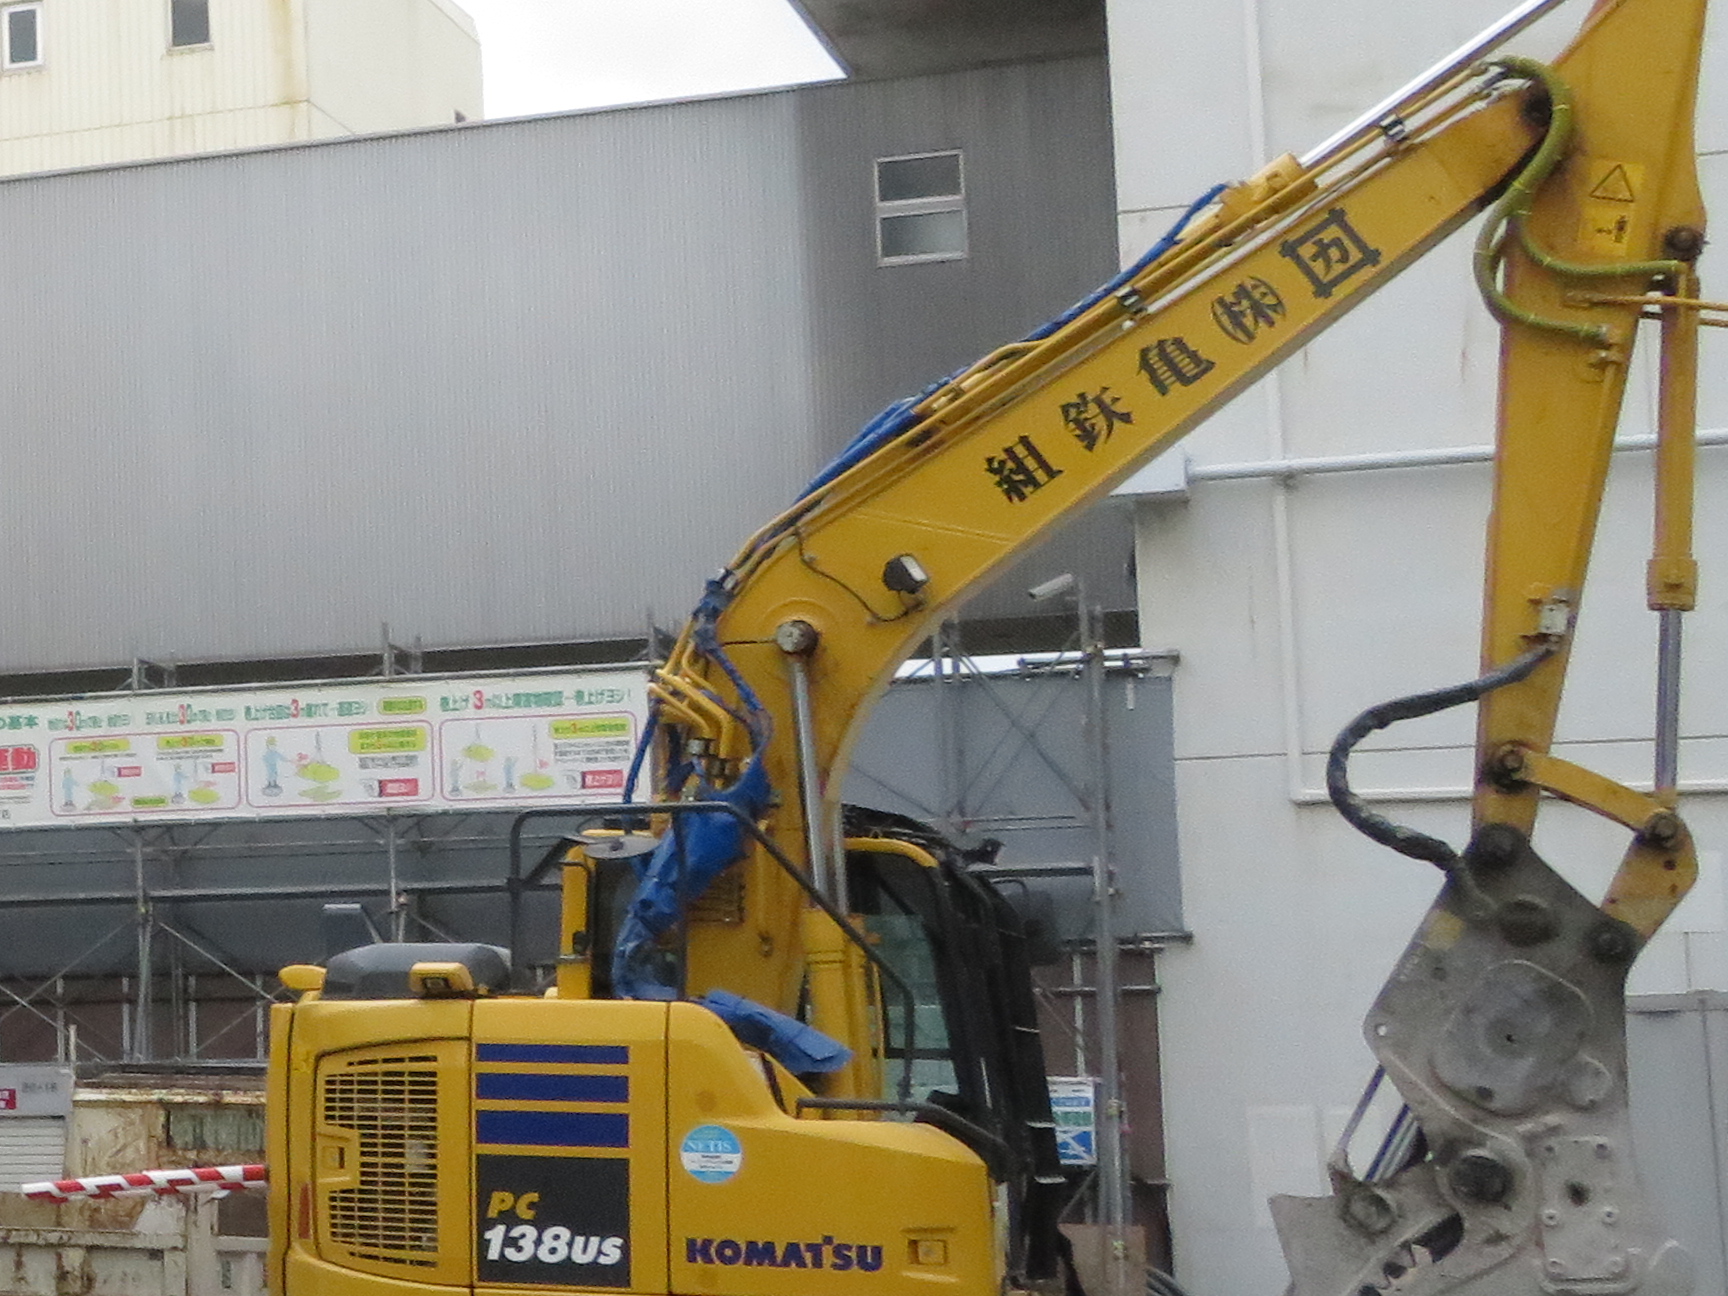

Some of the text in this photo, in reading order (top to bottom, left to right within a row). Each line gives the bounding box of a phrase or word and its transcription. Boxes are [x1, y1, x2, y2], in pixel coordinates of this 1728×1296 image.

[487, 1191, 539, 1218] PC
[483, 1224, 624, 1266] 138US
[686, 1235, 883, 1272] KOMATSU
